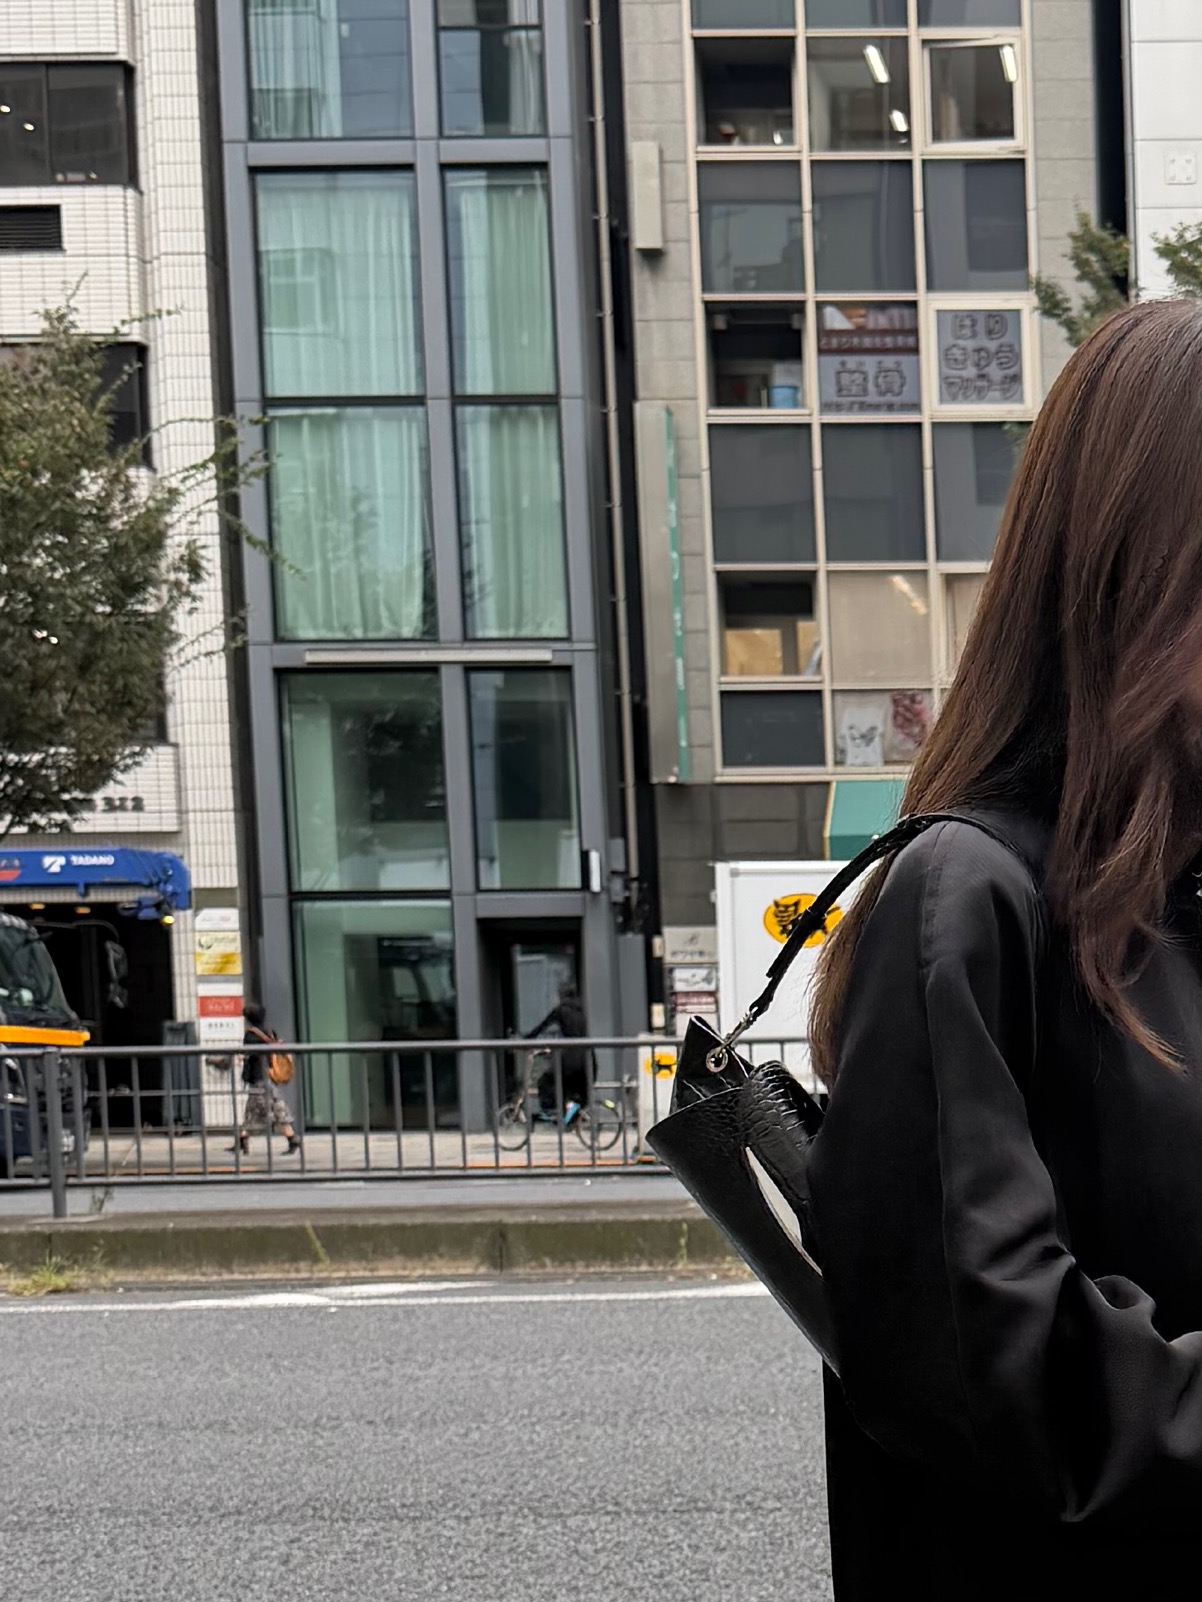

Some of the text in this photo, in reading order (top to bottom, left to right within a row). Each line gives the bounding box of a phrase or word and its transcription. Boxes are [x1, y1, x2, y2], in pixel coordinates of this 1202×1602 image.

[952, 313, 1008, 341] はり
[944, 343, 1019, 370] きゅう
